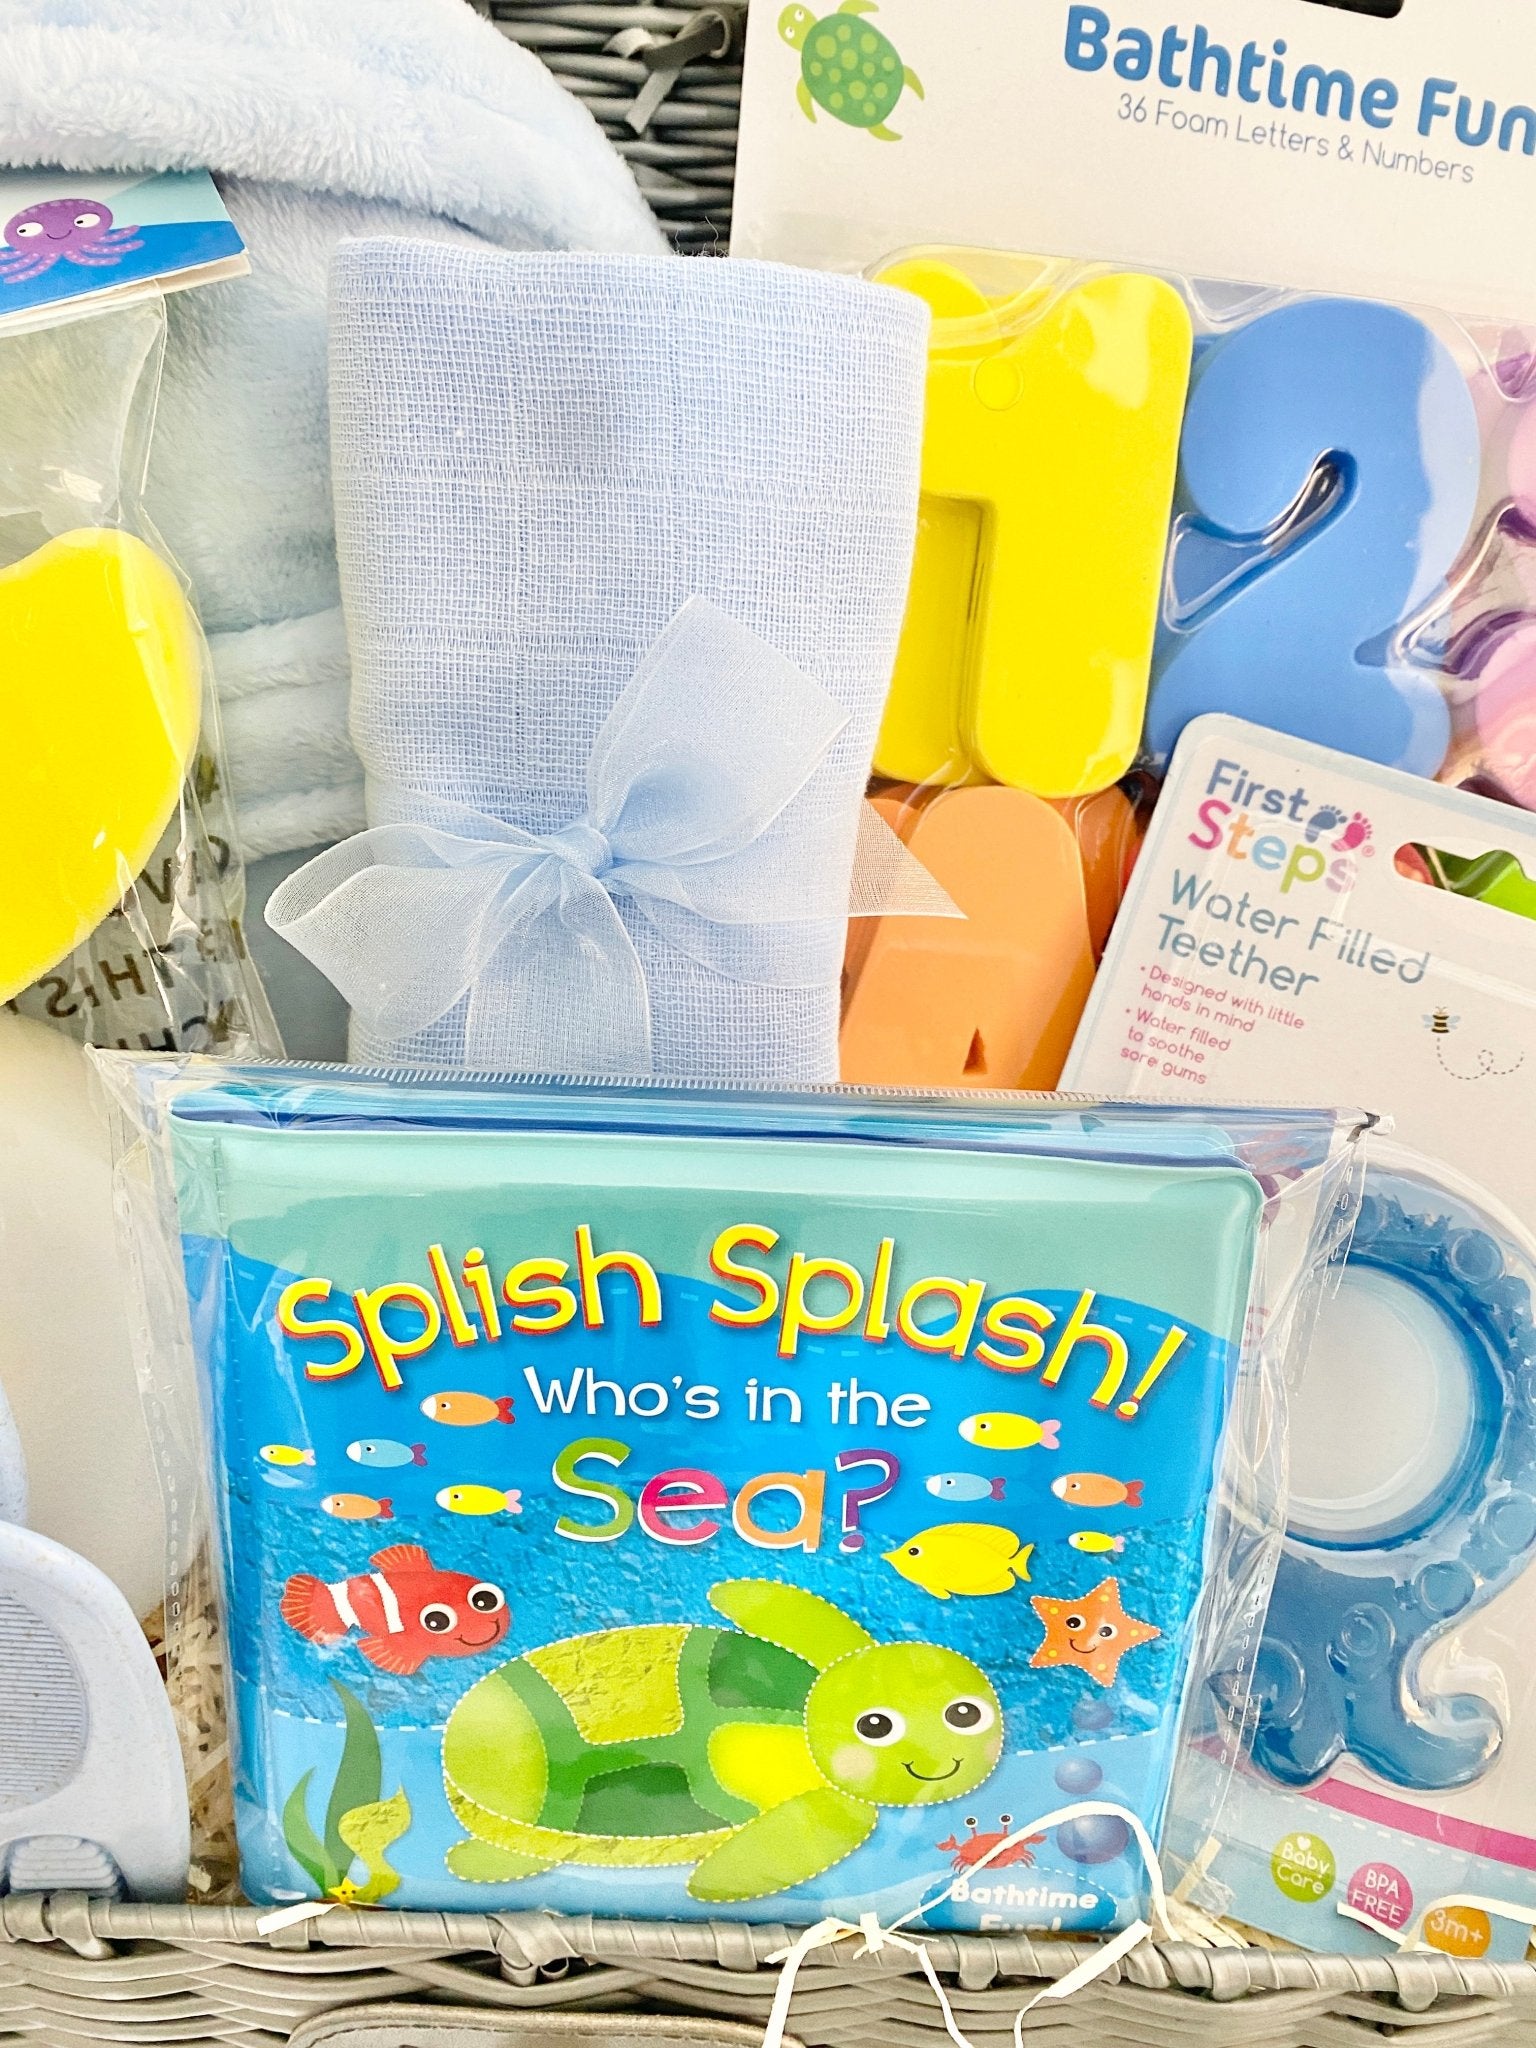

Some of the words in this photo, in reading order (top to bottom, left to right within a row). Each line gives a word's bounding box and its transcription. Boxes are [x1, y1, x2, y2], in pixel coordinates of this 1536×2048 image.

[1063, 4, 1399, 128] Bathtime
[1417, 77, 1536, 156] Fun
[1117, 93, 1148, 122] 36
[1155, 99, 1228, 138] Foam
[1236, 114, 1329, 157] Letters
[1337, 135, 1355, 160] &
[1362, 139, 1474, 183] Numbers
[1206, 759, 1309, 822] First
[1188, 799, 1358, 894] Steps
[1172, 869, 1299, 940] Water
[1308, 916, 1431, 984] Filled
[1156, 913, 1319, 996] Teether
[1141, 983, 1191, 1012] hands
[1196, 1003, 1210, 1018] in
[1214, 1011, 1256, 1032] mind
[1149, 965, 1228, 1002] Designed
[1231, 995, 1264, 1017] with
[1267, 1006, 1304, 1029] little
[1128, 1026, 1143, 1042] to
[1147, 1036, 1205, 1063] soothe
[1137, 1007, 1186, 1035] Water
[1190, 1027, 1232, 1051] filled
[1120, 1047, 1157, 1067] sore
[1161, 1062, 1207, 1084] gums
[277, 1224, 662, 1392] Splish
[708, 1223, 1188, 1421] Splash!
[523, 1366, 720, 1419] Who's
[745, 1378, 802, 1423] in
[827, 1378, 931, 1427] the
[552, 1436, 901, 1553] Sea?
[1276, 1864, 1324, 1894] Care
[1281, 1841, 1331, 1878] Baby
[1364, 1869, 1400, 1899] BPA
[951, 1879, 1099, 1909] Bathtime
[1352, 1890, 1404, 1924] FREE
[1429, 1909, 1483, 1946] 3m+
